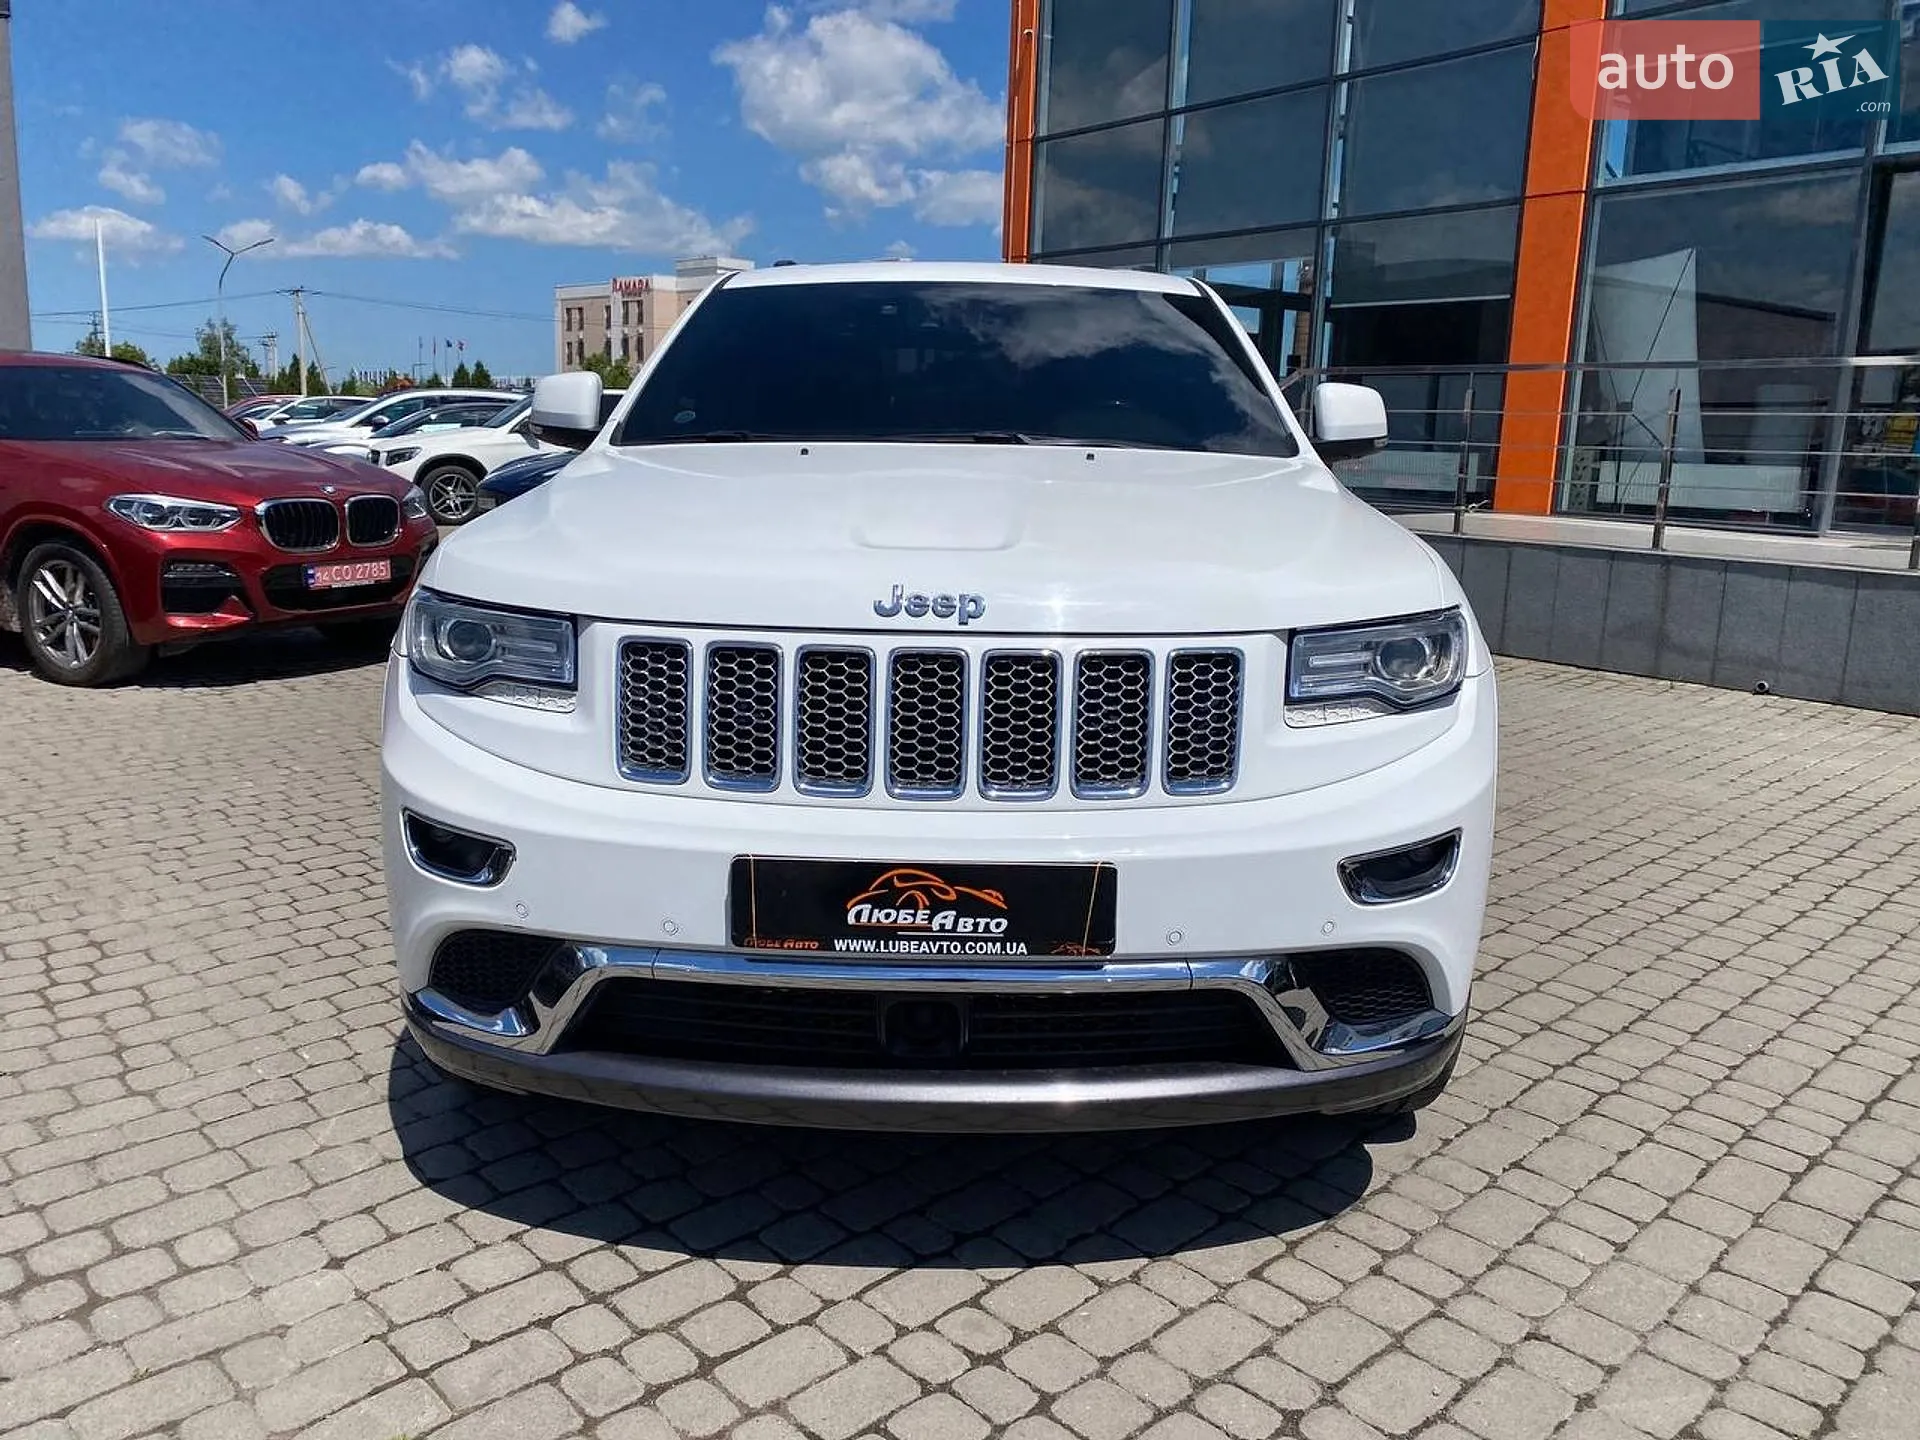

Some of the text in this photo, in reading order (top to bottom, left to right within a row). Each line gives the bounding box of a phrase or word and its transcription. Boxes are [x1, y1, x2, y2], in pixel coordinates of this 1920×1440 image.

[355, 562, 387, 579] 2785
[873, 584, 986, 626] Jeep
[834, 938, 1028, 955] WWW.LUBEAVTO.COM.UA
